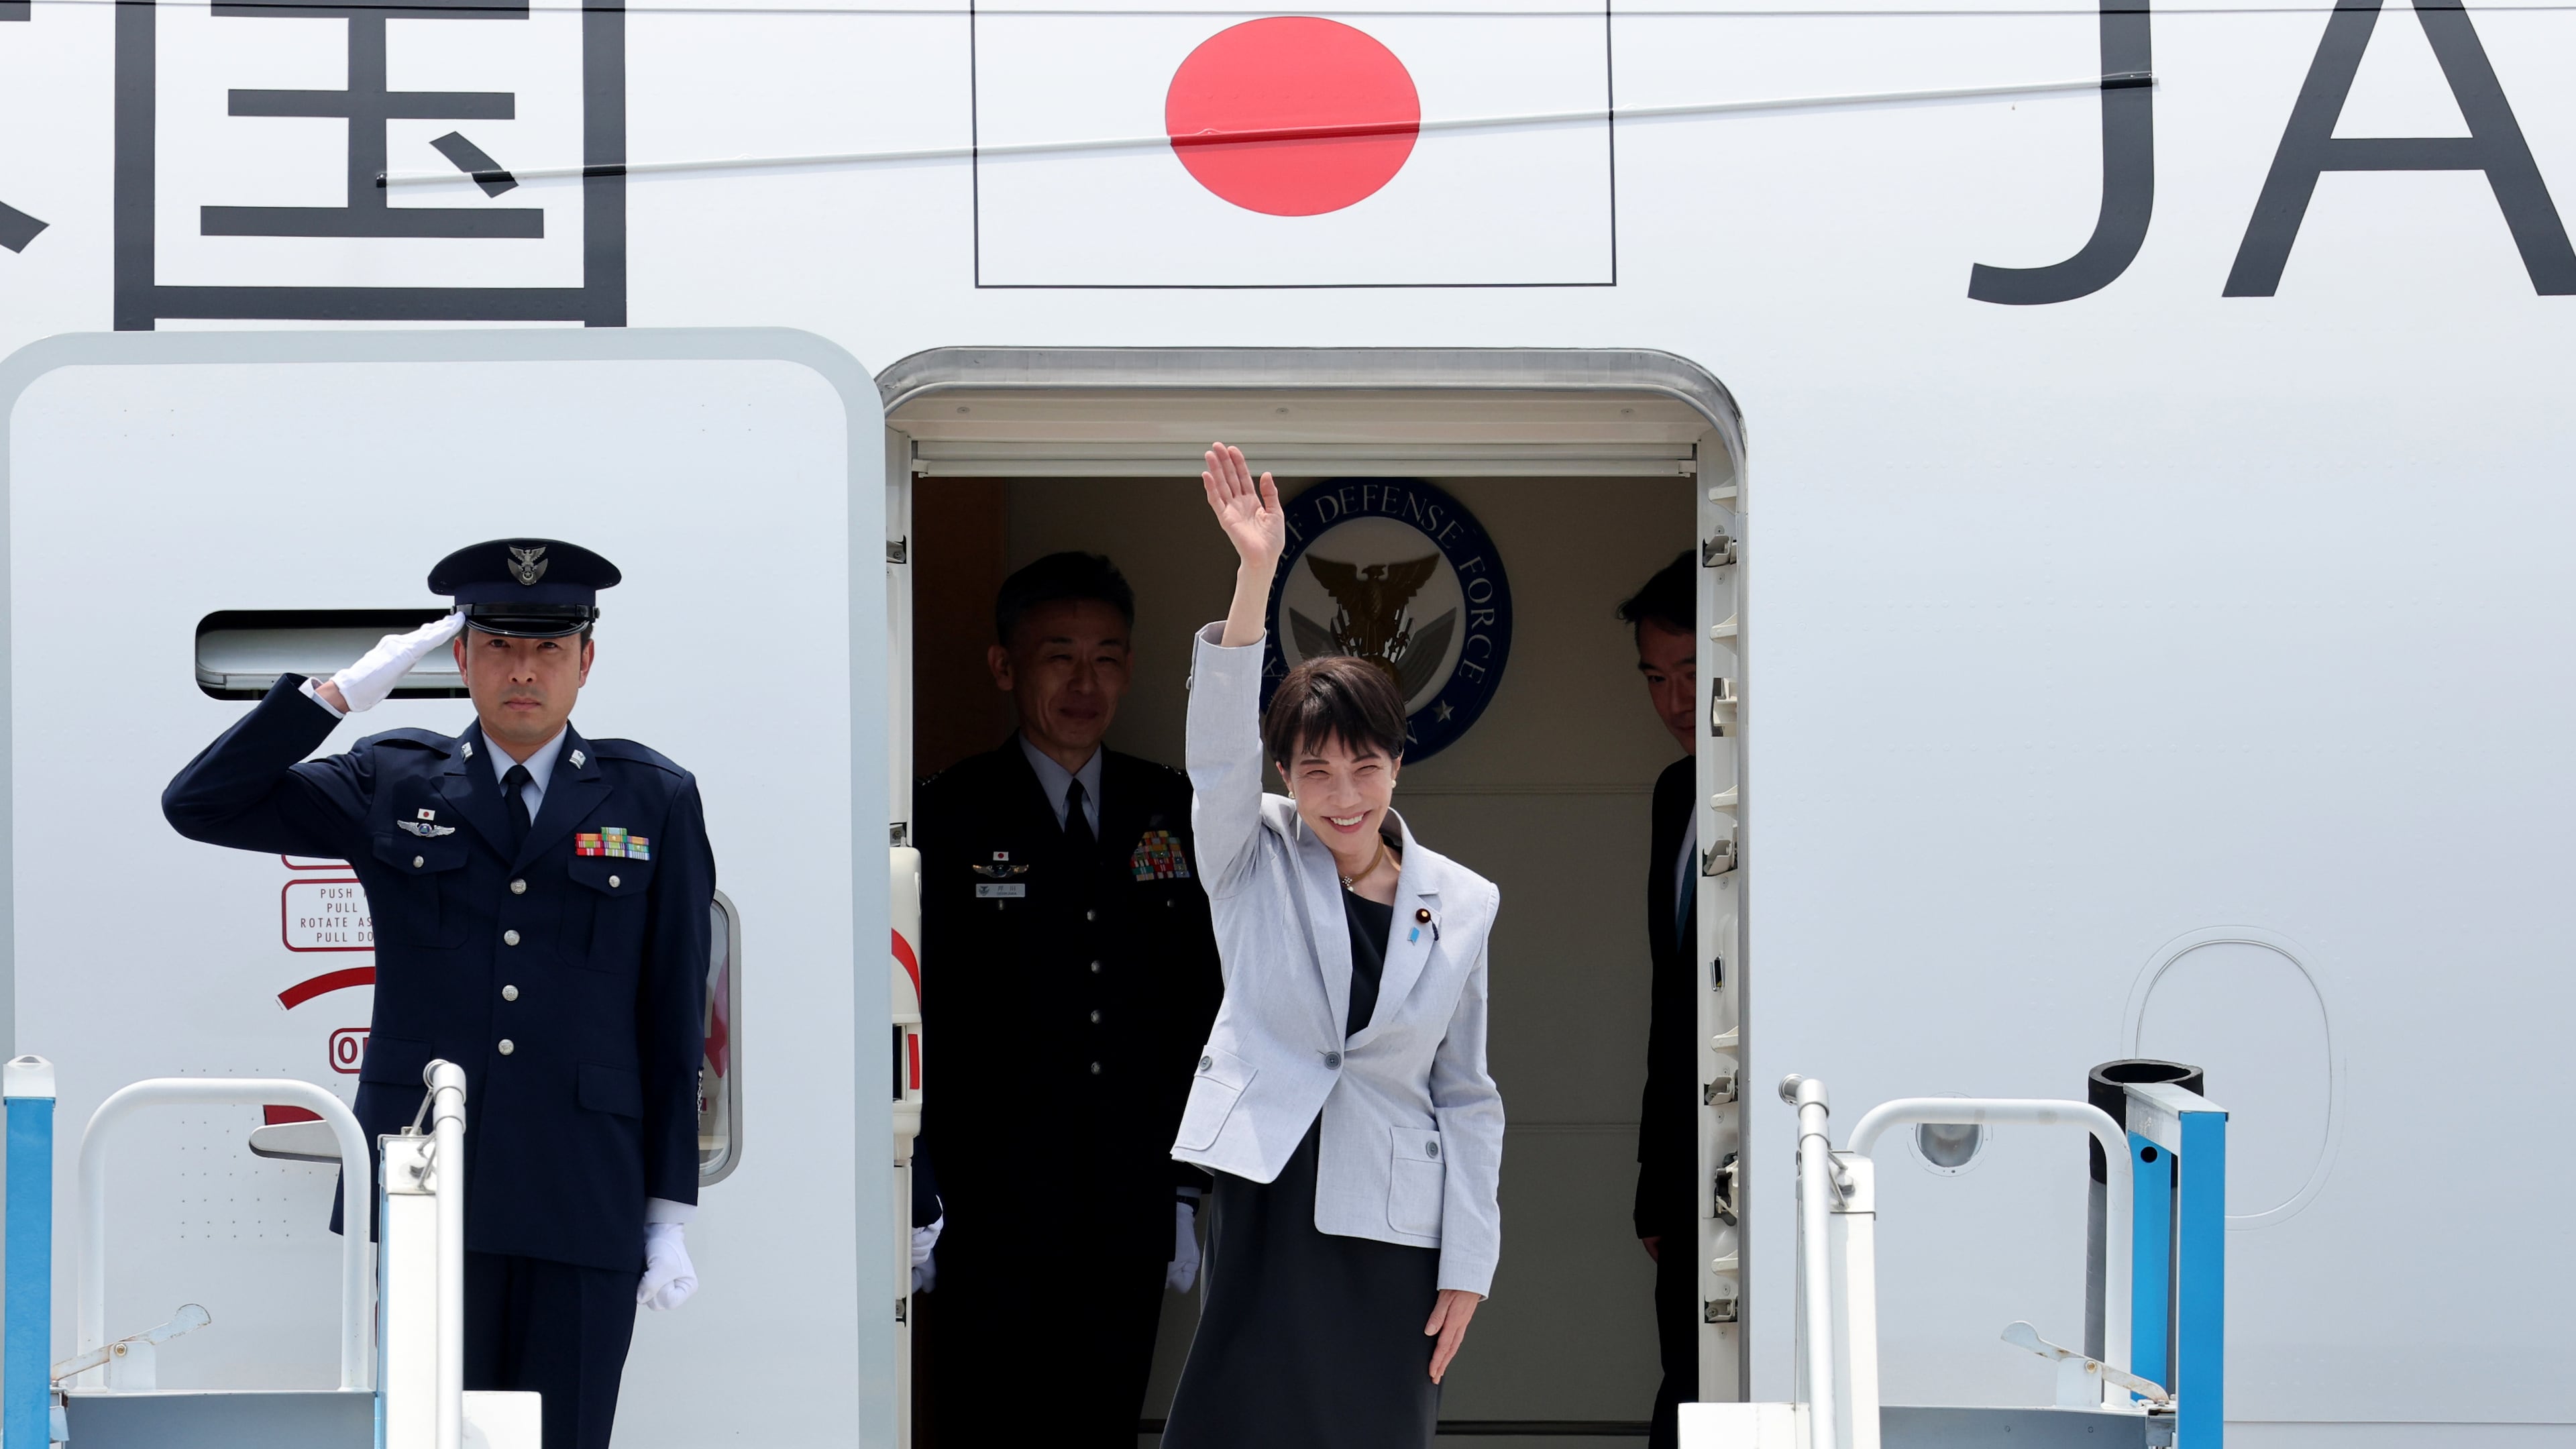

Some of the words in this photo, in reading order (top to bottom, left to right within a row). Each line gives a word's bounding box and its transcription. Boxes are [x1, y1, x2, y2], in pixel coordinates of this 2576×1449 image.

[1316, 484, 1464, 549] DEFENSE
[1458, 556, 1495, 685] FORCE
[321, 888, 352, 899] PUSH
[327, 903, 358, 913] PULL
[301, 918, 348, 928] ROTATE
[317, 932, 348, 943] PULL
[337, 1036, 368, 1064] O
